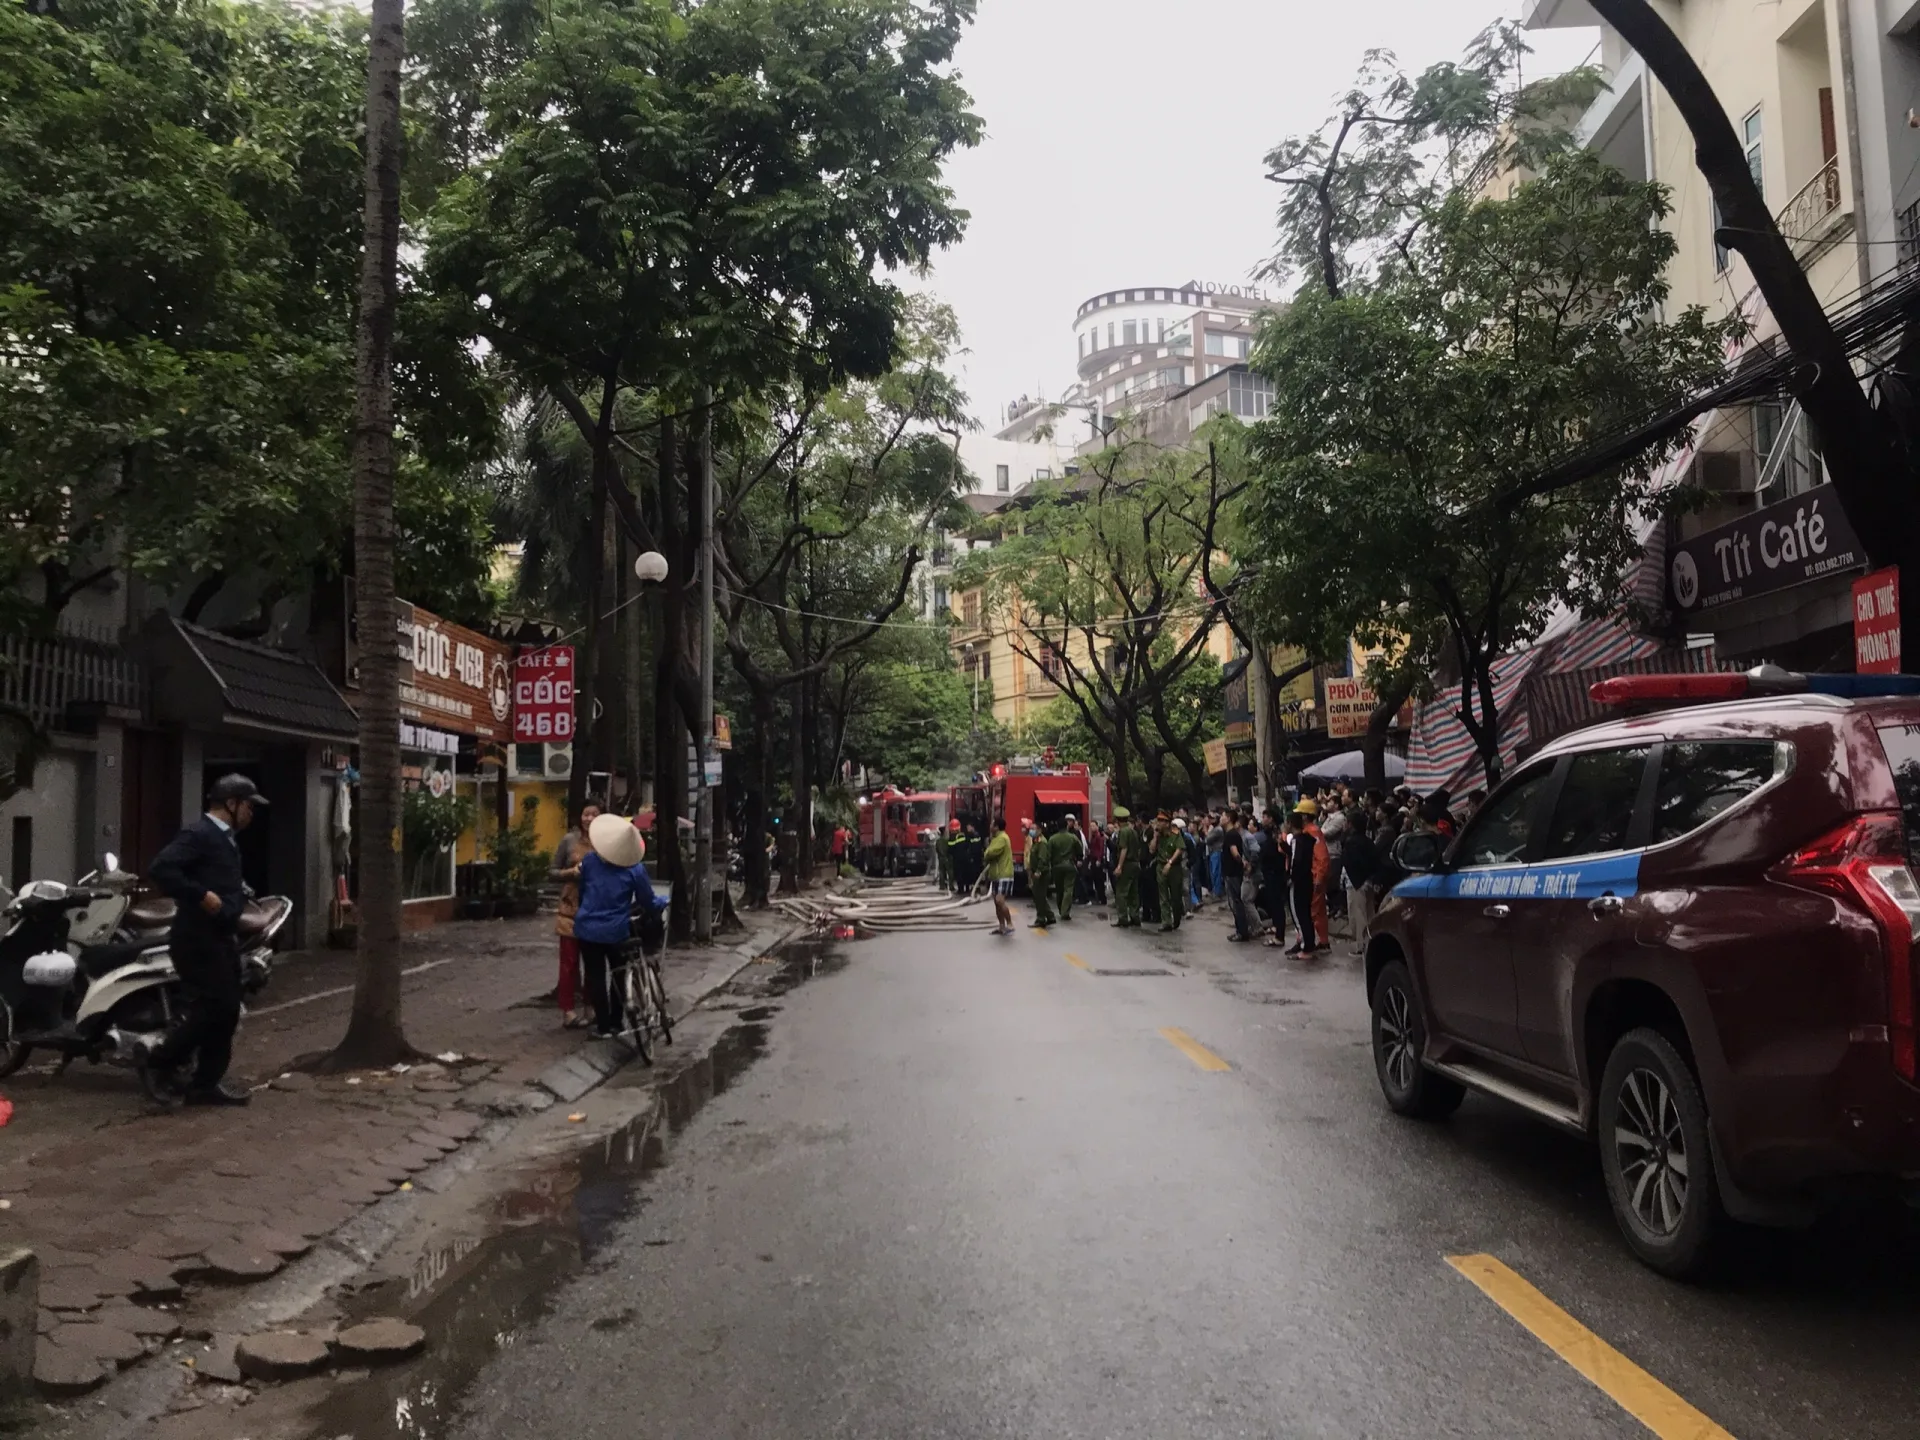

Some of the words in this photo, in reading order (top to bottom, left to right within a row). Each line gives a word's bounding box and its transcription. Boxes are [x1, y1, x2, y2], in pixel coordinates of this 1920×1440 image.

[1192, 279, 1271, 302] NOVOTEL
[1714, 530, 1753, 583] Tít
[1759, 499, 1828, 569] Café
[1857, 591, 1874, 622] CHO
[1875, 578, 1896, 618] THUÊ
[413, 621, 450, 679] CỐC
[454, 642, 484, 689] 468
[518, 651, 551, 668] CAFÉ
[1857, 627, 1889, 665] PHÒNG
[515, 671, 572, 705] CỐC
[1328, 679, 1356, 700] PHỞ
[1329, 702, 1351, 714] CƠM
[1353, 701, 1378, 713] RANG
[516, 712, 571, 736] 468
[1477, 873, 1493, 895] SÁT
[1491, 876, 1511, 895] GIAO
[1510, 871, 1538, 895] THÔNG
[1543, 870, 1566, 898] TRẬT
[1566, 871, 1581, 898] TỰ
